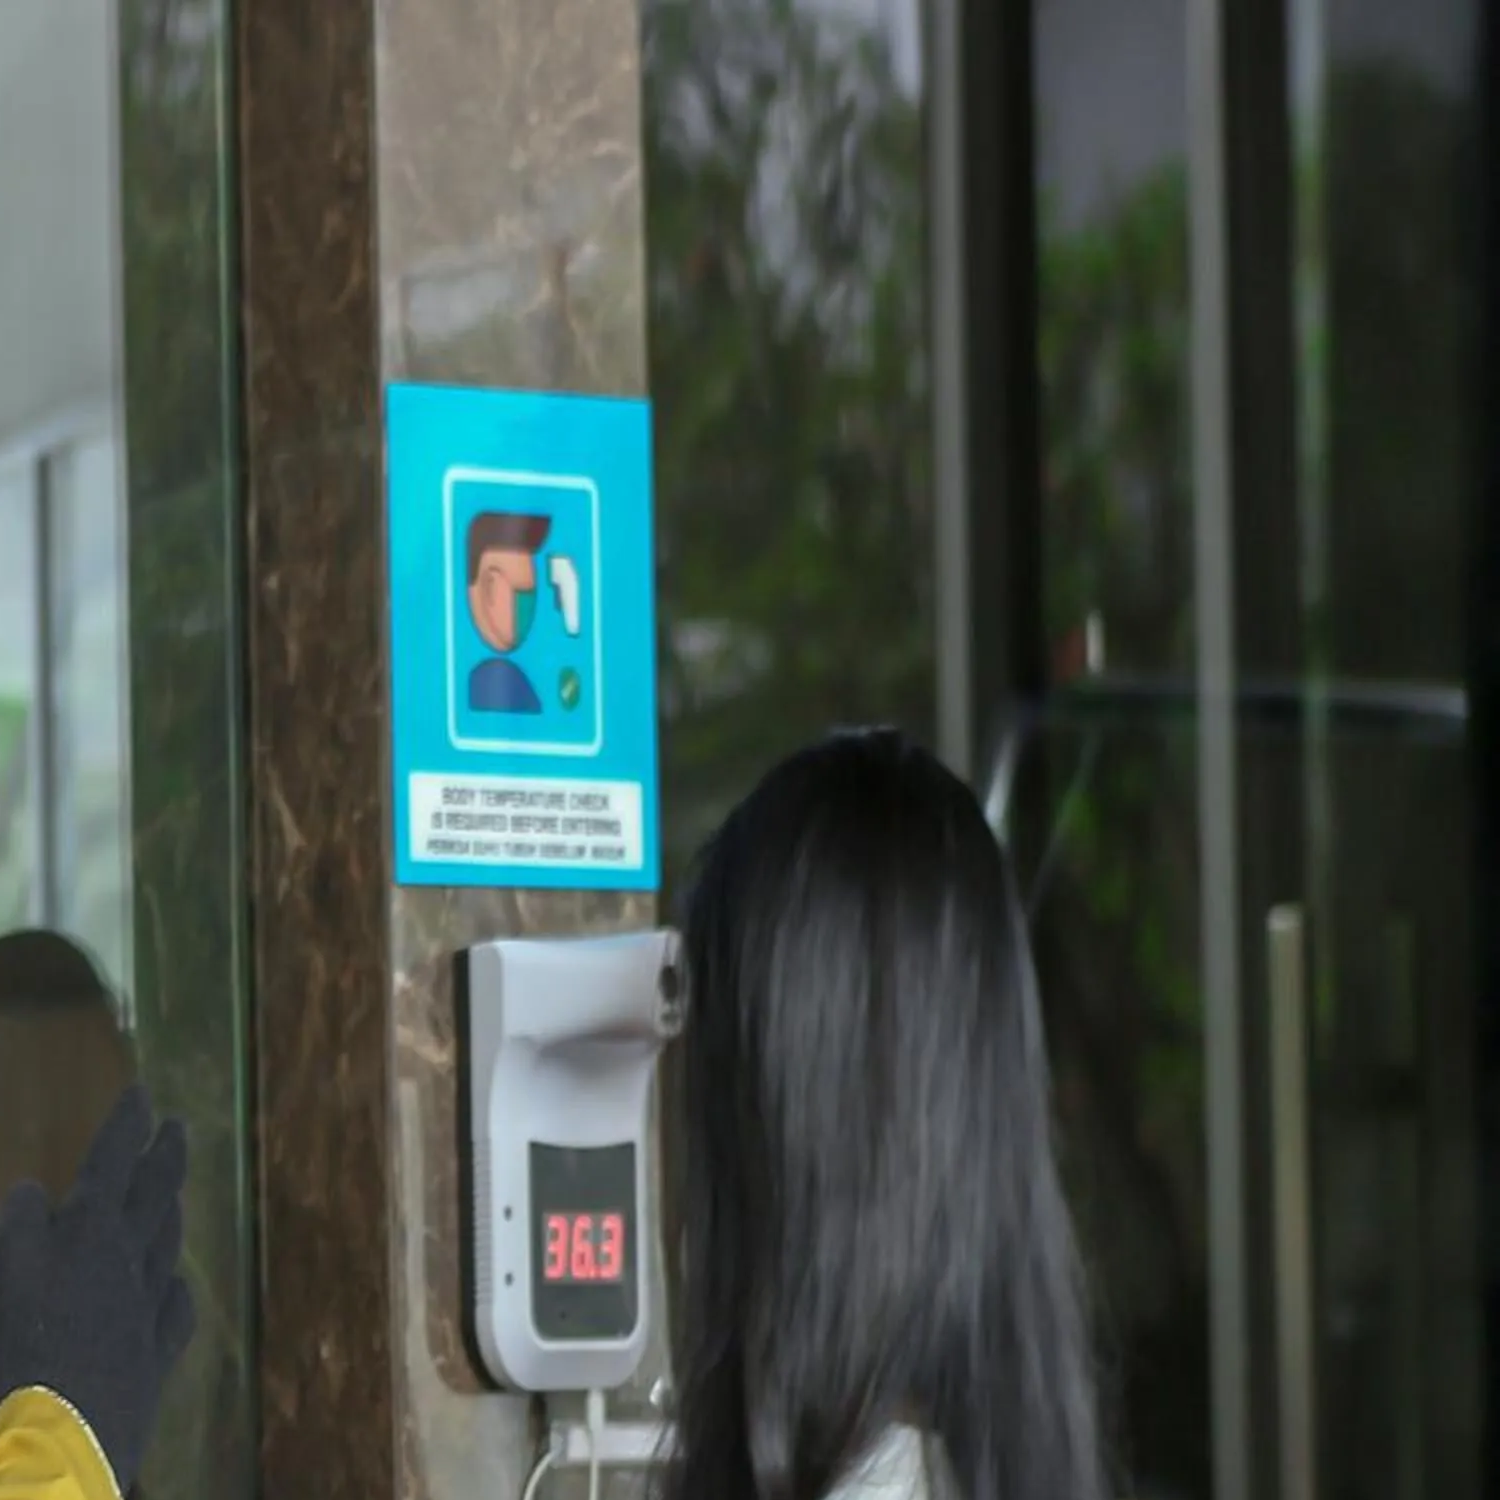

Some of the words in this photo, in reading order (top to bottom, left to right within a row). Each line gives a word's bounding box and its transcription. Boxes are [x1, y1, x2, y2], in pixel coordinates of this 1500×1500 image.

[442, 787, 475, 806] BODY
[480, 788, 565, 810] TEMPERATURE
[569, 792, 610, 811] CHECK
[446, 812, 508, 832] REQUIRED
[510, 815, 559, 833] BEFORE
[561, 816, 622, 836] ENTERING
[543, 1213, 625, 1280] 36.3
